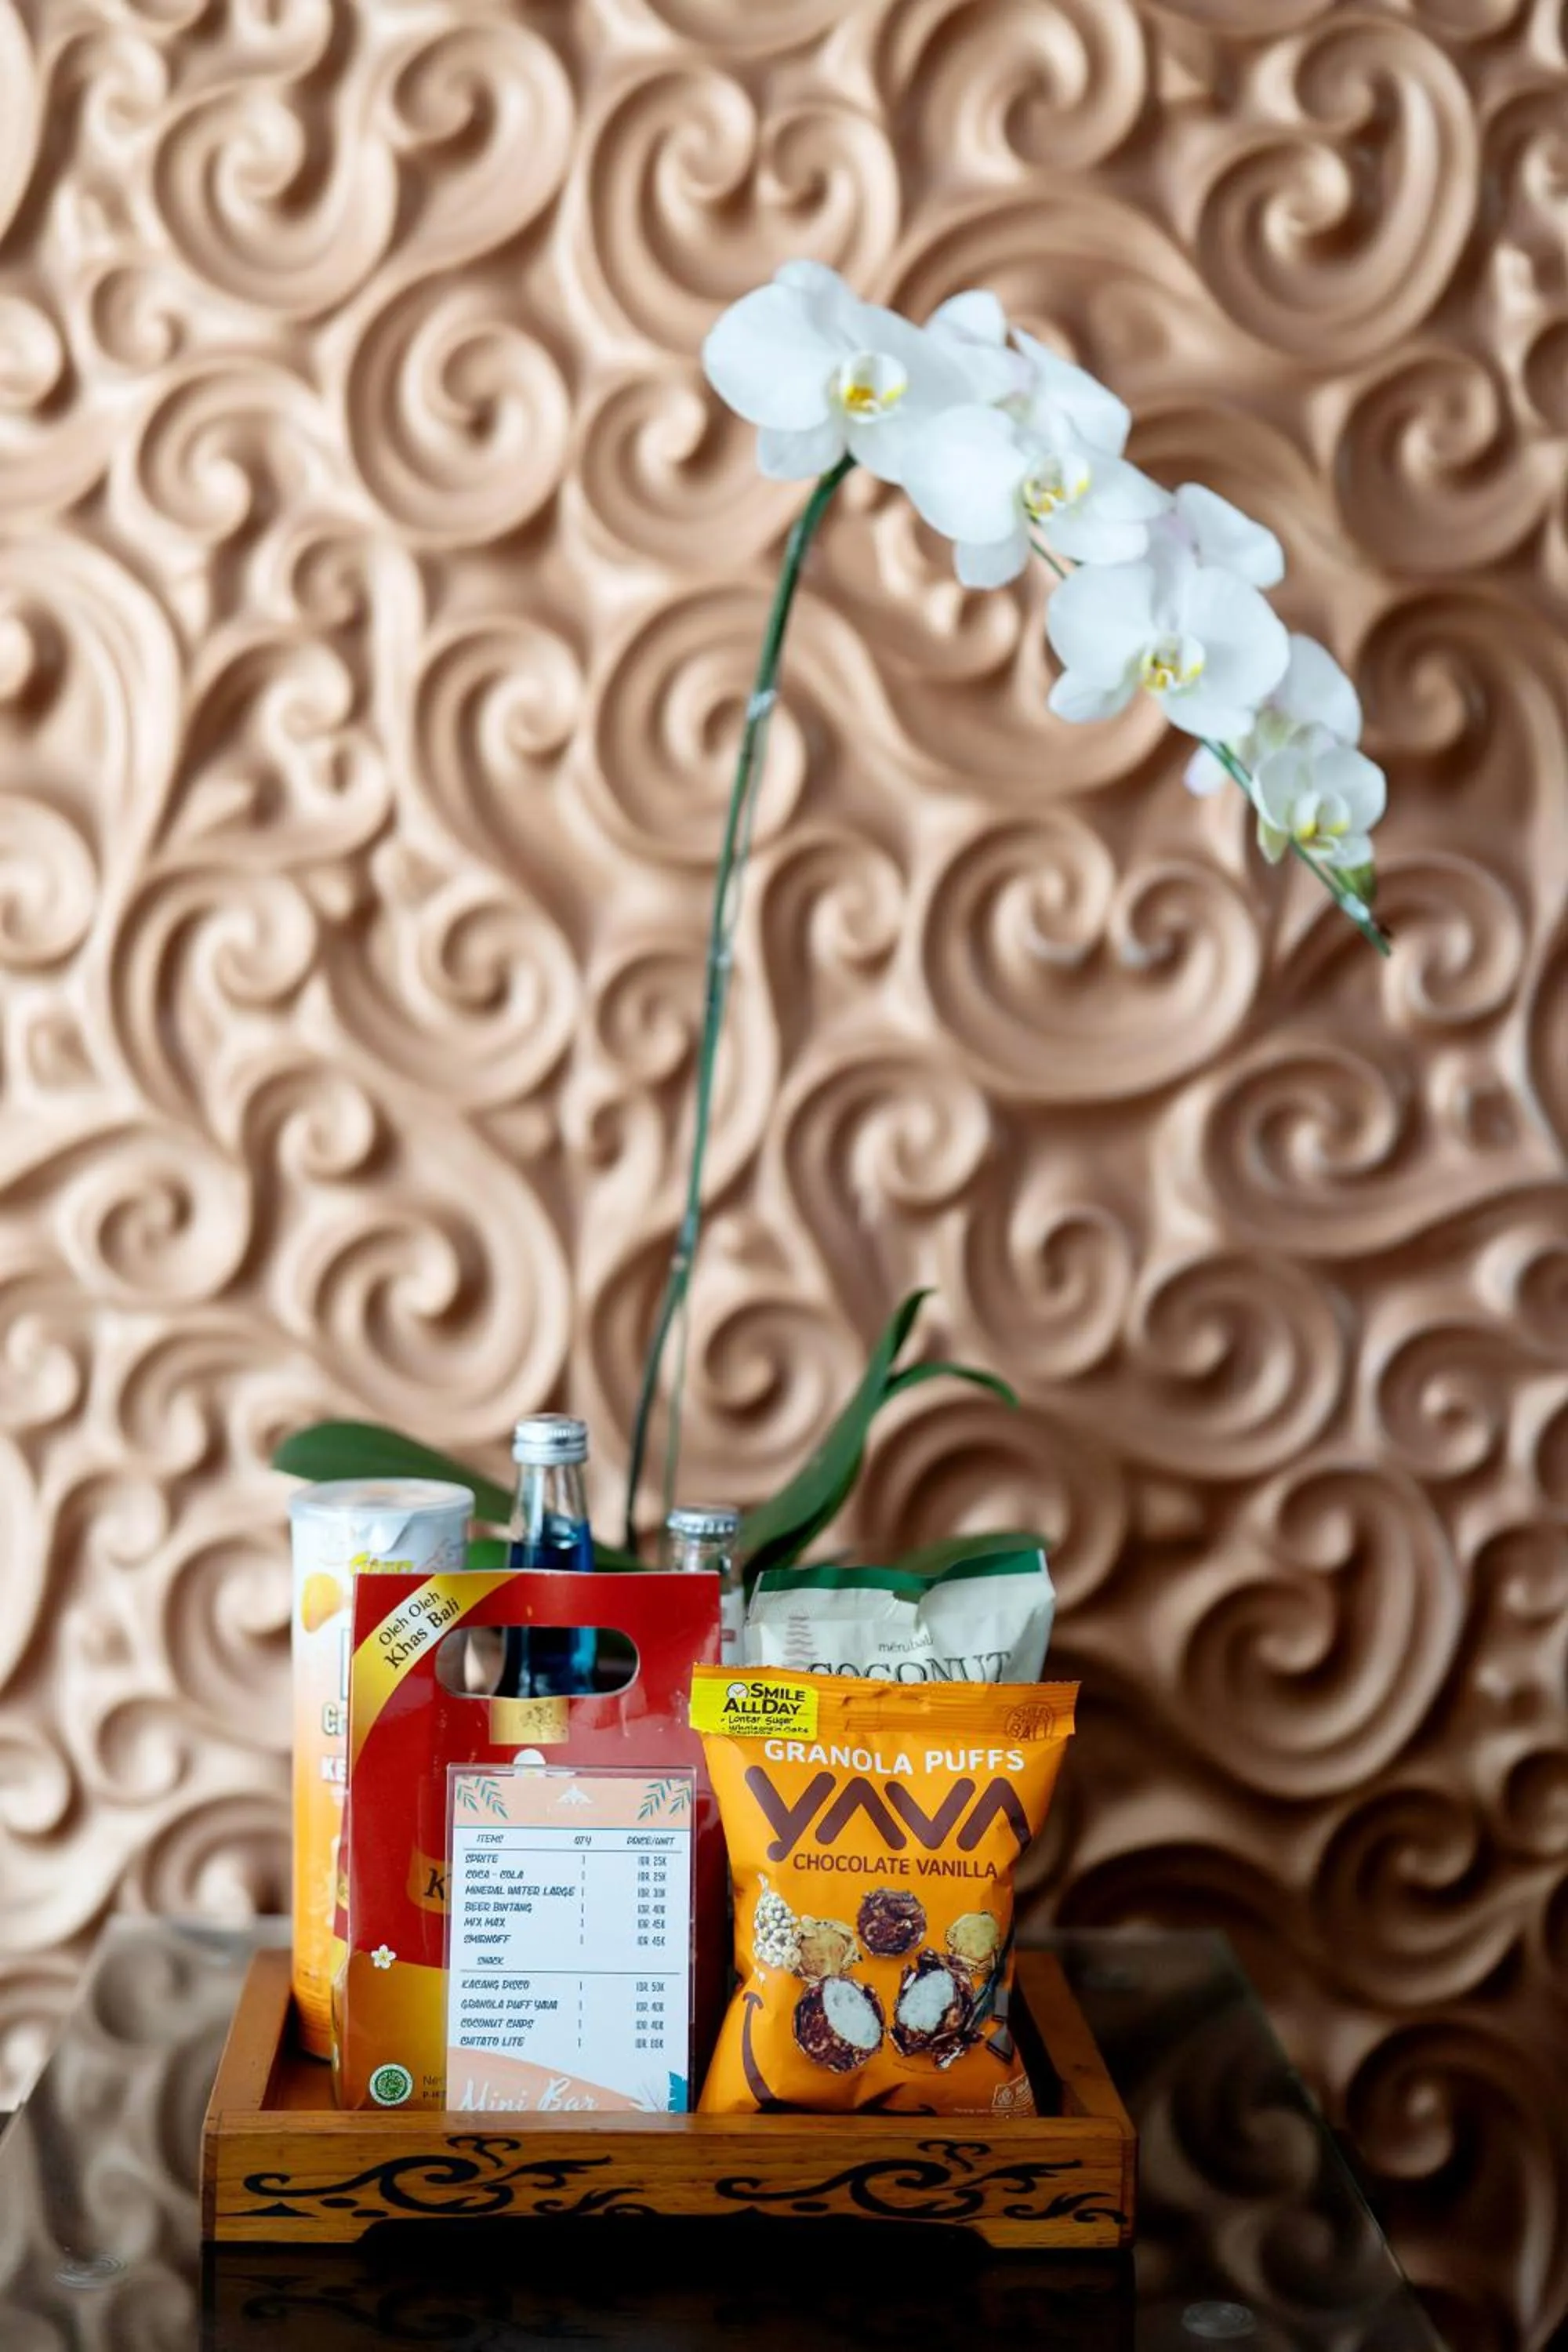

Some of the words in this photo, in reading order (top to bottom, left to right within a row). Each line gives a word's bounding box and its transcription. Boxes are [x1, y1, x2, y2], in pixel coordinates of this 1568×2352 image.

[379, 1618, 409, 1646] Oleh
[408, 1592, 441, 1617] Oleh
[384, 1628, 428, 1669] Khas
[426, 1598, 460, 1628] Bali
[750, 1682, 806, 1702] SMILE
[764, 1739, 913, 1775] GRANOLA
[925, 1748, 1025, 1773] PUFFS
[744, 1765, 1033, 1863] YAVA
[477, 1834, 504, 1843] ITEMS
[465, 1853, 499, 1864] SPRITE
[793, 1853, 910, 1875] CHOCOLATE
[916, 1859, 998, 1879] VANILLA
[465, 1870, 490, 1880] COCA
[499, 1870, 524, 1880] COLA
[465, 1886, 505, 1896] MINERAL
[507, 1886, 539, 1896] WATER
[543, 1886, 575, 1897] LARGE
[464, 1902, 491, 1912] BEER
[493, 1902, 532, 1913] BINTANG
[464, 1917, 482, 1928] MIX
[484, 1917, 506, 1928] MAX
[463, 1934, 511, 1944] SMIRNOFF
[462, 1980, 499, 1991] KACANG
[460, 1999, 503, 2009] GRANOLA
[506, 2000, 533, 2009] PUFF
[460, 2018, 504, 2028] COCONUT
[506, 2019, 535, 2029] CHIPS
[460, 2036, 499, 2046] CHITATO
[502, 2036, 525, 2046] LITE
[460, 2078, 529, 2111] Mini
[539, 2077, 598, 2111] Bar
